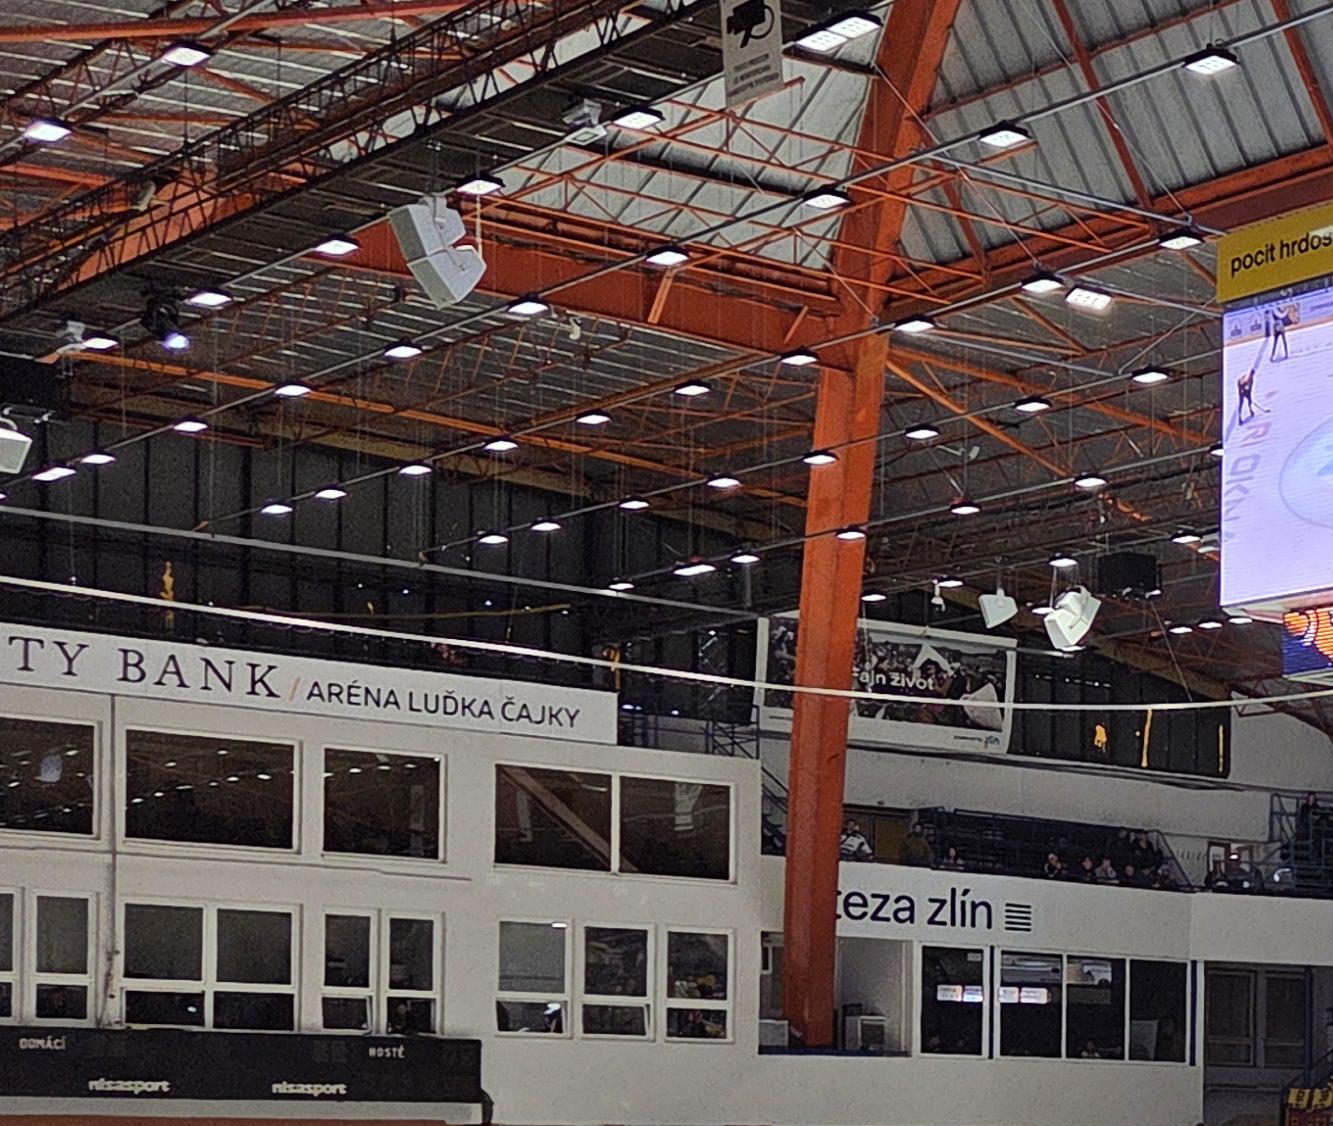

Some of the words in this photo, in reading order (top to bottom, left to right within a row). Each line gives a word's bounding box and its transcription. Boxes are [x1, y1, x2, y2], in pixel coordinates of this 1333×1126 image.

[1230, 244, 1275, 277] pocit
[117, 647, 282, 698] BANK
[889, 671, 935, 691] život
[306, 676, 401, 711] ARÉNA
[408, 686, 496, 722] LUĎKA
[501, 693, 581, 729] ČAJKY
[927, 887, 994, 930] zlín
